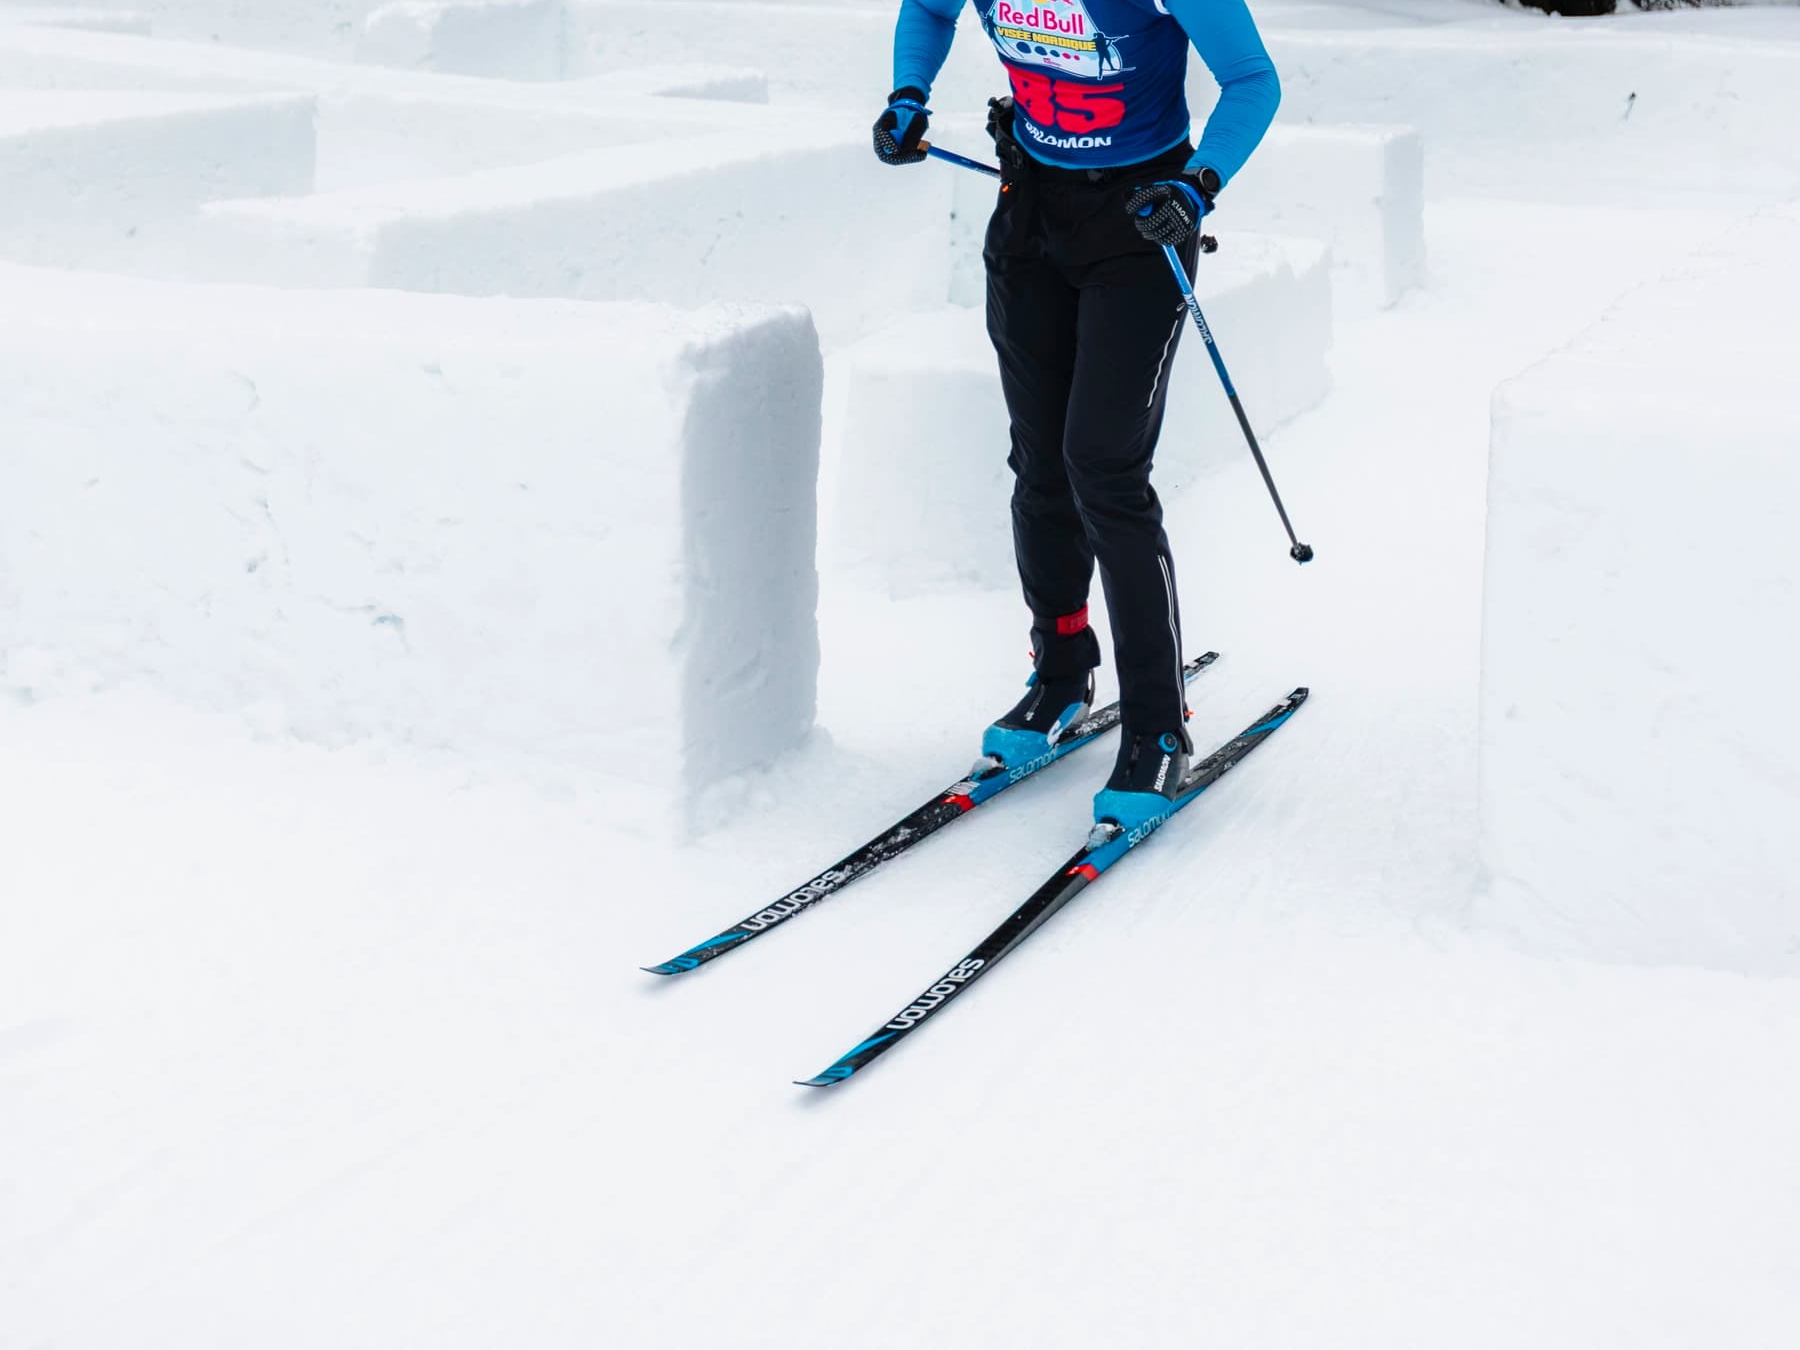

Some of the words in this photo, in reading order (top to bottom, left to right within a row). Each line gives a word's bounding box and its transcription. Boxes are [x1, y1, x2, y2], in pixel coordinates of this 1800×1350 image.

[998, 1, 1039, 28] Red
[1043, 9, 1084, 35] Bull
[997, 26, 1031, 40] VISÉE
[1032, 32, 1096, 51] NORDIQUE
[1003, 62, 1125, 134] 85
